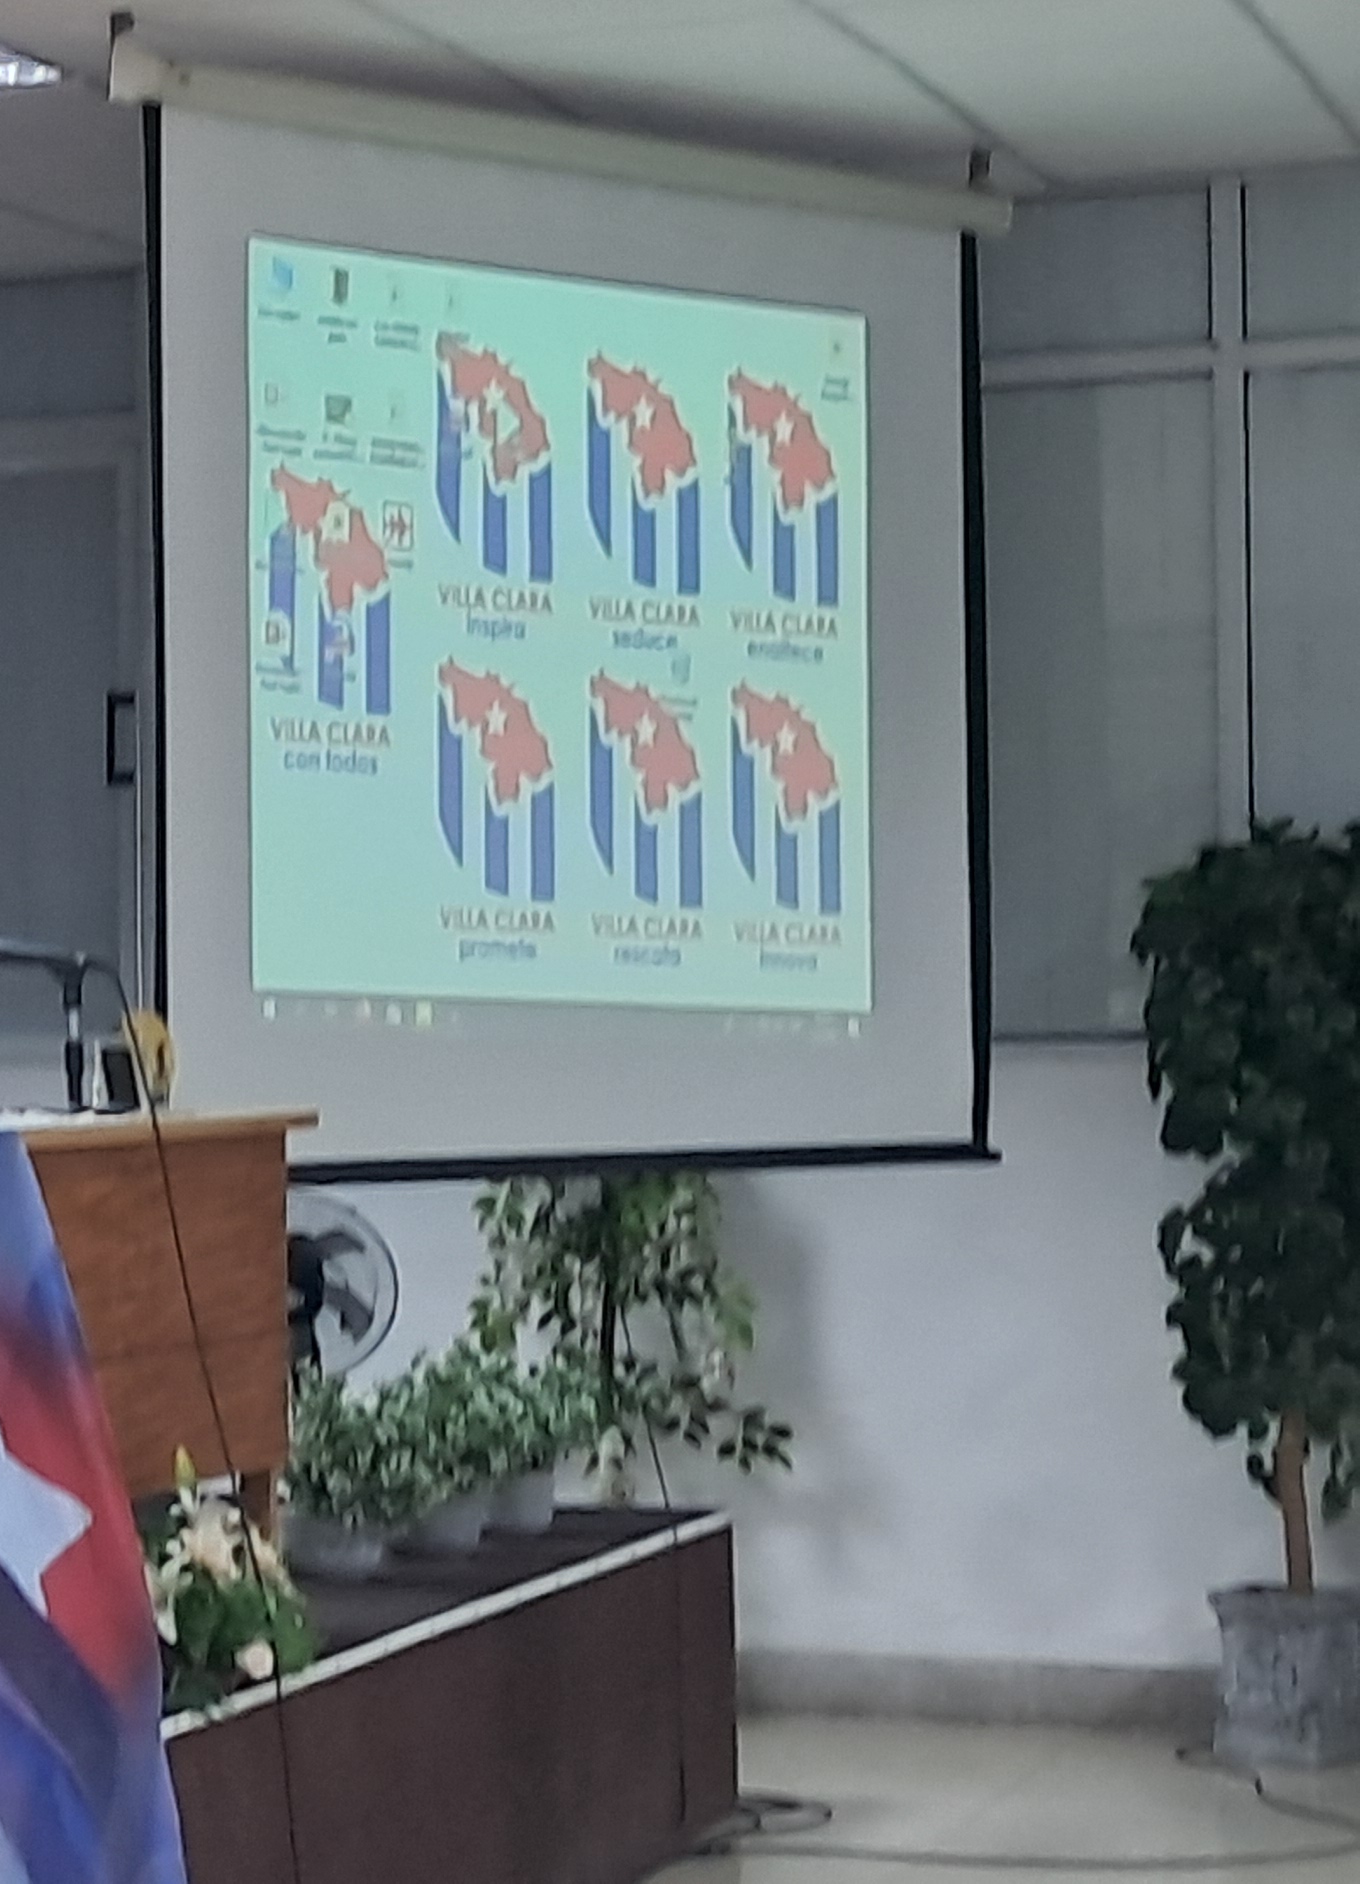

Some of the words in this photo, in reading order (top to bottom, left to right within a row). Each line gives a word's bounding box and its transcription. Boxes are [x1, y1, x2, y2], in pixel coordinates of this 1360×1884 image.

[438, 582, 487, 610] VILLA
[491, 584, 553, 616] CLARA
[588, 596, 637, 622] VILLA
[641, 599, 700, 627] CLARA
[729, 608, 777, 634] VILLA
[781, 611, 839, 641] CLARA
[270, 715, 322, 744] VILLA
[326, 719, 391, 749] CLARA
[440, 904, 490, 930] VILLA
[493, 906, 556, 934] CLARA
[591, 911, 640, 938] VILLA
[643, 913, 702, 942] CLARA
[733, 919, 781, 944] VILLA
[783, 920, 842, 947] CLARA
